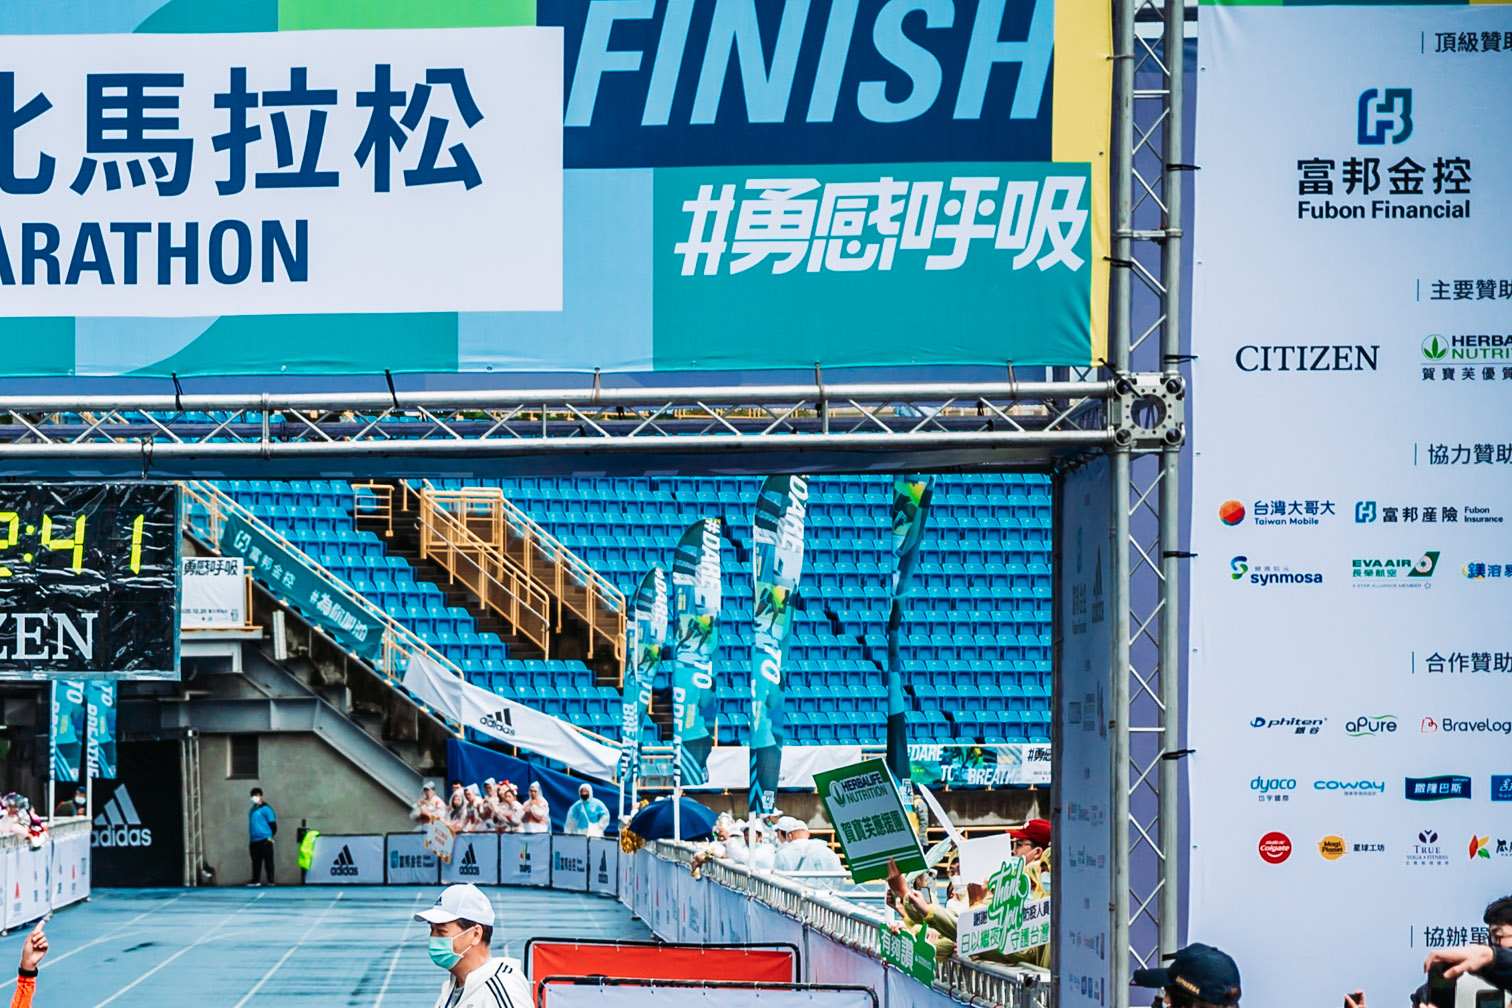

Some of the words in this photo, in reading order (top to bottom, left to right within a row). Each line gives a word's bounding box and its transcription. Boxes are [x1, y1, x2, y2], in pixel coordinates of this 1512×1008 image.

[564, 0, 1055, 126] FINISH
[1297, 156, 1472, 196] 富邦金控
[1298, 201, 1365, 219] Fubon
[1371, 200, 1470, 218] Financial
[674, 176, 1088, 276] #勇感呼吸
[1236, 345, 1379, 371] CITIZEN
[1452, 348, 1512, 359] NUTRI
[780, 474, 808, 548] DARE
[1254, 500, 1336, 516] 台灣大哥大
[1464, 506, 1490, 514] Fubon
[1255, 517, 1287, 525] Taiwan
[1289, 517, 1319, 525] Mobile
[1464, 515, 1504, 523] Insurance
[249, 547, 296, 590] 富邦金控
[1352, 568, 1397, 577] 長榮航空
[1250, 573, 1323, 586] synmosa
[760, 645, 783, 685] TO
[693, 660, 713, 689] TO
[66, 680, 84, 704] TO
[101, 682, 113, 707] TO
[479, 715, 516, 736] adidas
[1345, 716, 1397, 733] aPure
[1442, 718, 1512, 734] Bravelog
[840, 773, 884, 792] HERBALIFE
[1250, 776, 1297, 793] dyaco
[1313, 780, 1385, 792] coway
[846, 785, 888, 804] NUTRITION
[91, 820, 152, 847] adidas
[1353, 844, 1385, 852] 星球工坊
[1413, 845, 1441, 854] TRUE
[330, 864, 359, 876] adidas
[458, 864, 480, 876] adidas
